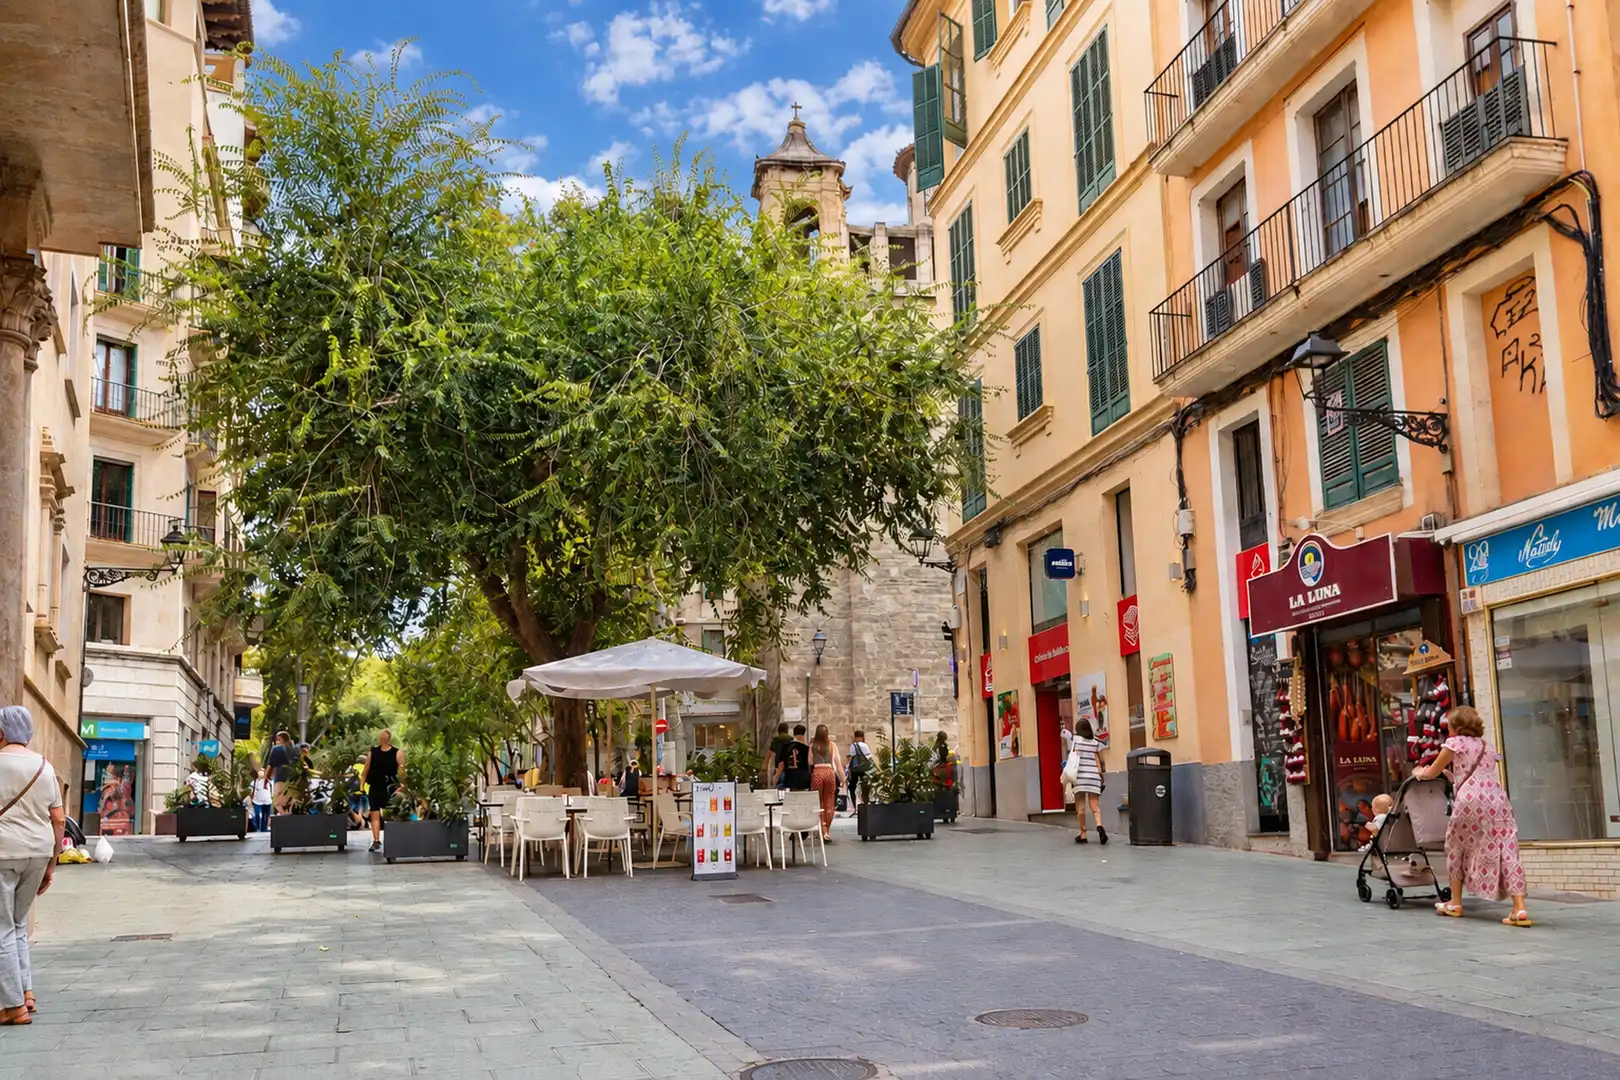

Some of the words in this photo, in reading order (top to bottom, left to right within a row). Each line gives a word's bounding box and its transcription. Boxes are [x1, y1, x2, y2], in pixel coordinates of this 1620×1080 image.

[1288, 594, 1306, 610] LA
[1307, 583, 1341, 604] LUNA
[1339, 756, 1352, 765] LA
[1353, 755, 1377, 763] LUNA
